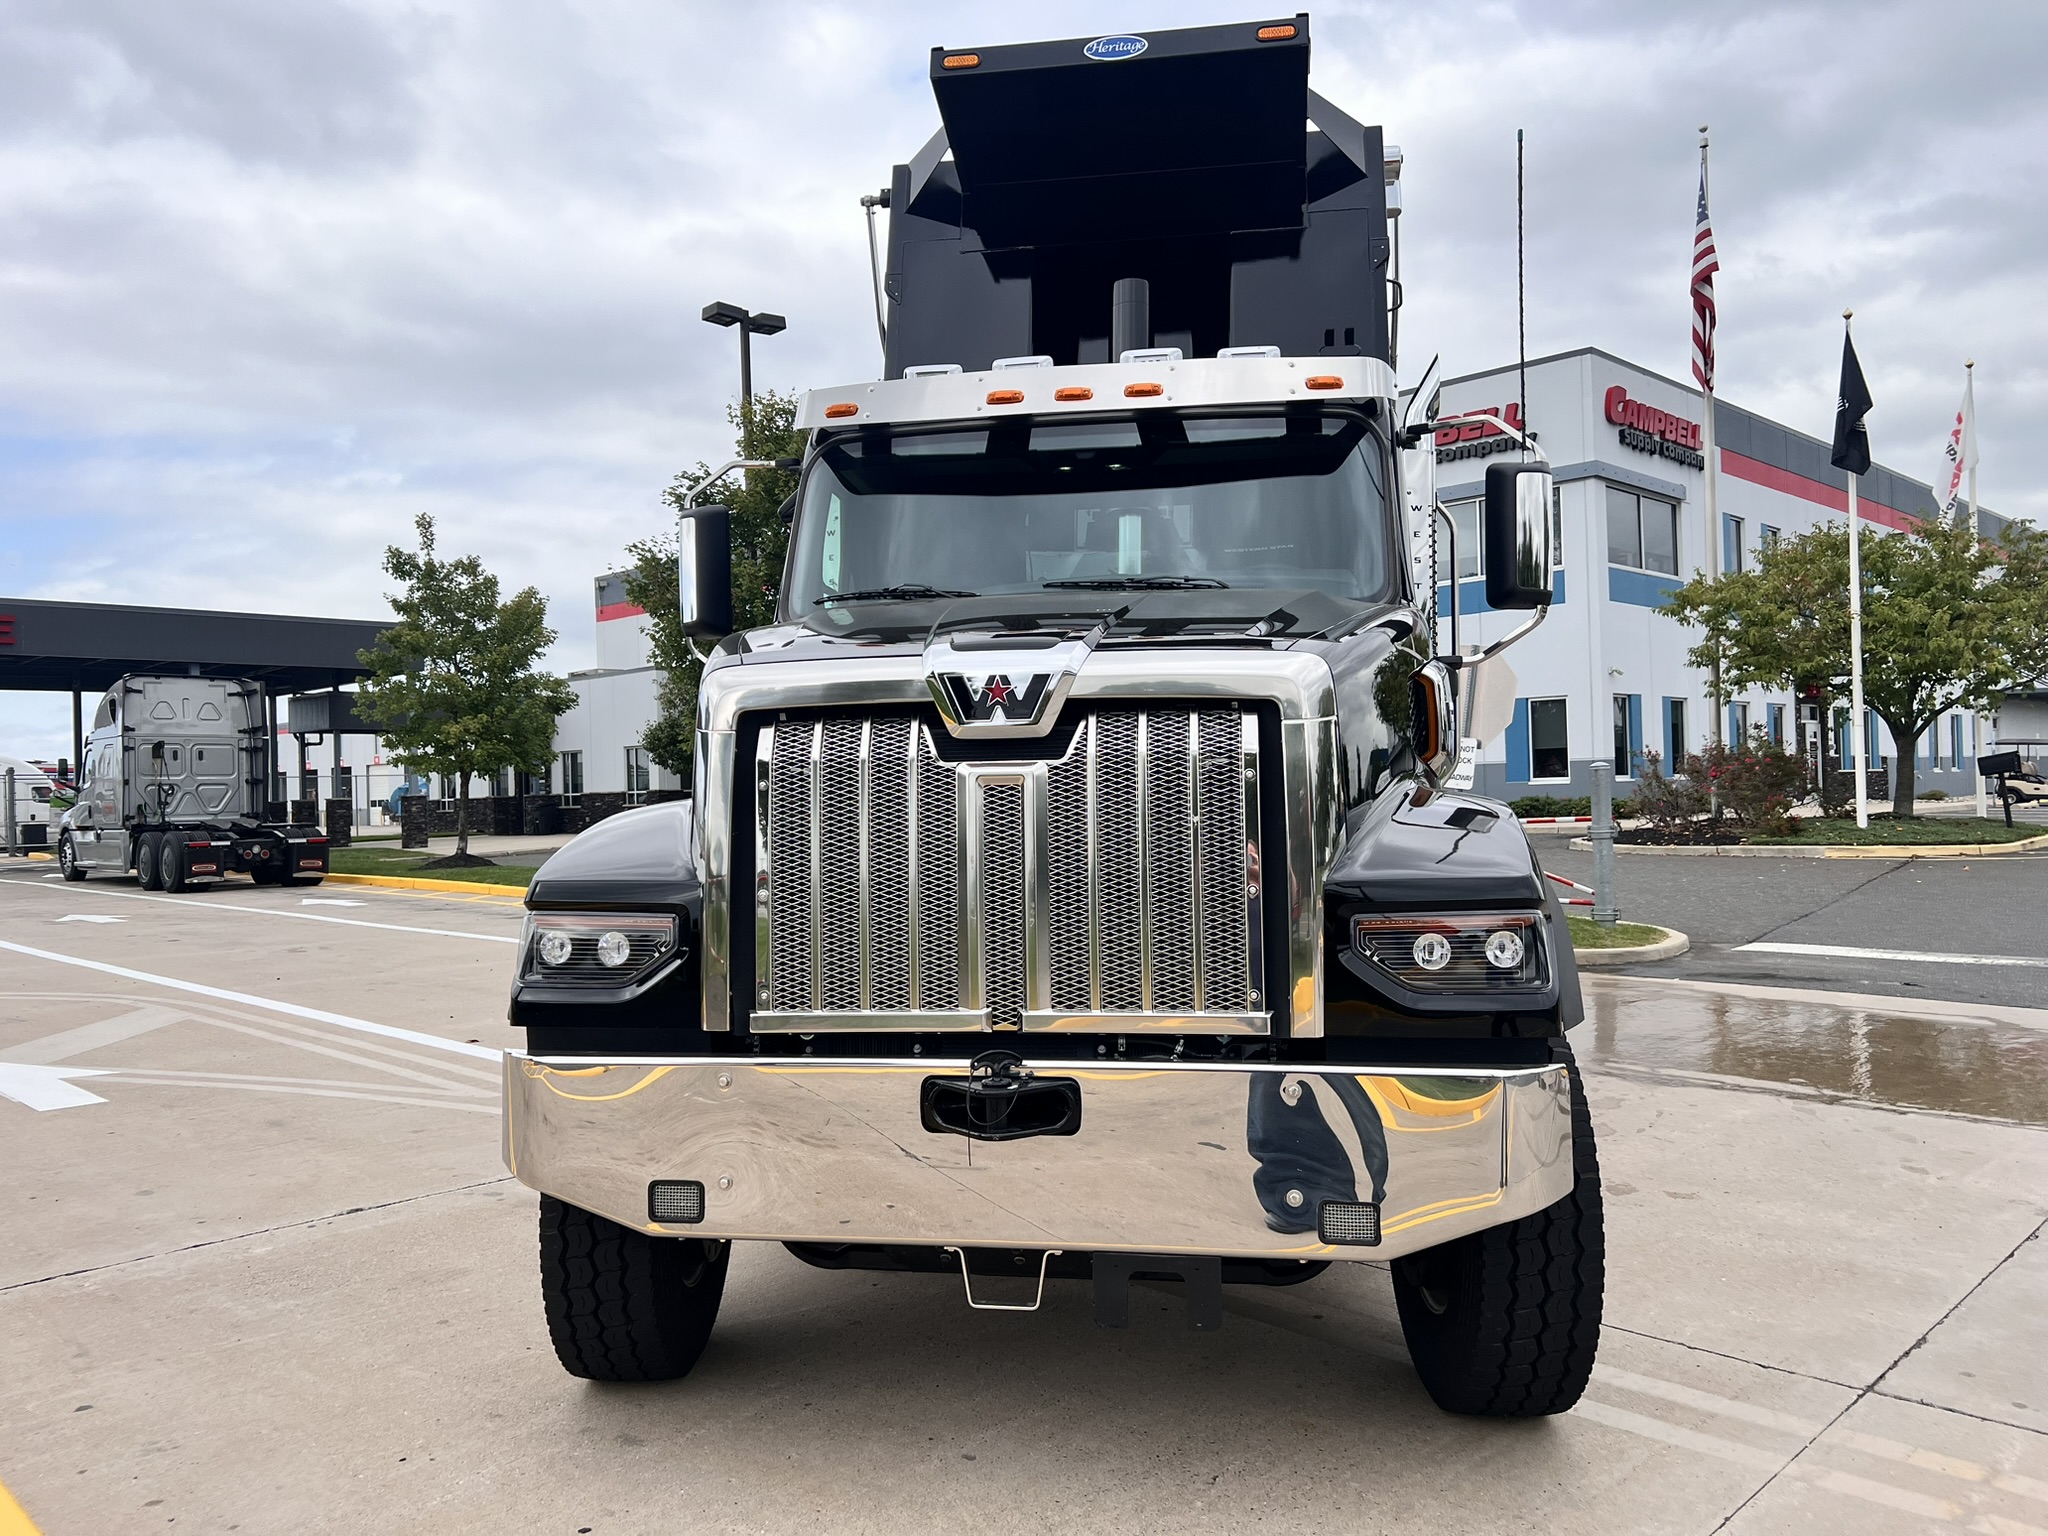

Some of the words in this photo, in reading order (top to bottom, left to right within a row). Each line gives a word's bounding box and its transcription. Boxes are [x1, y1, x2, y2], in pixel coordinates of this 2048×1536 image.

[1087, 40, 1145, 54] Heritage
[1435, 403, 1523, 446] BELL
[1452, 774, 1473, 782] ADWAY
